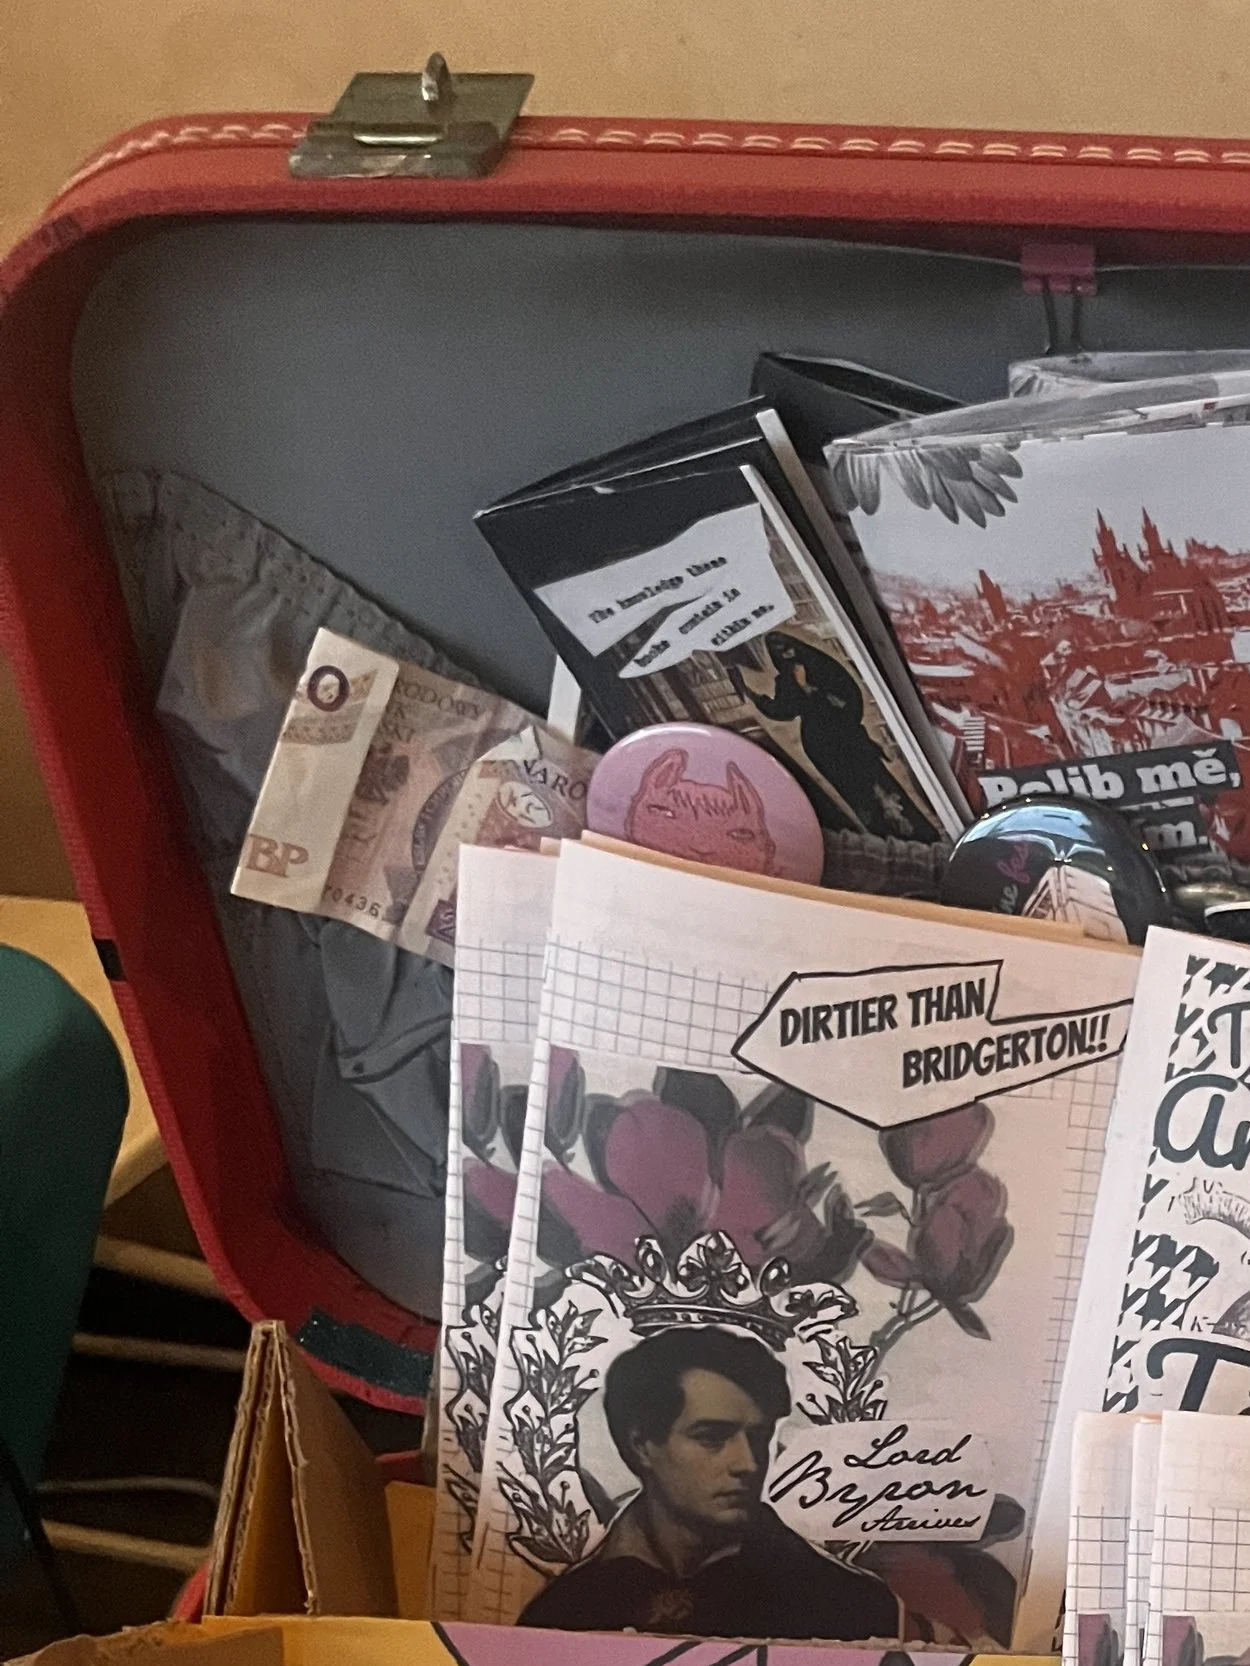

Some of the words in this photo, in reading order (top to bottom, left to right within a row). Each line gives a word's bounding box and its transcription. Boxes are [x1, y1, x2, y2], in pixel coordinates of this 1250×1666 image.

[779, 993, 897, 1047] DIRTIER
[907, 978, 986, 1027] THAN
[902, 1013, 1111, 1088] BRIDGERTON!!
[844, 1424, 972, 1469] Lord
[769, 1450, 987, 1528] Byron
